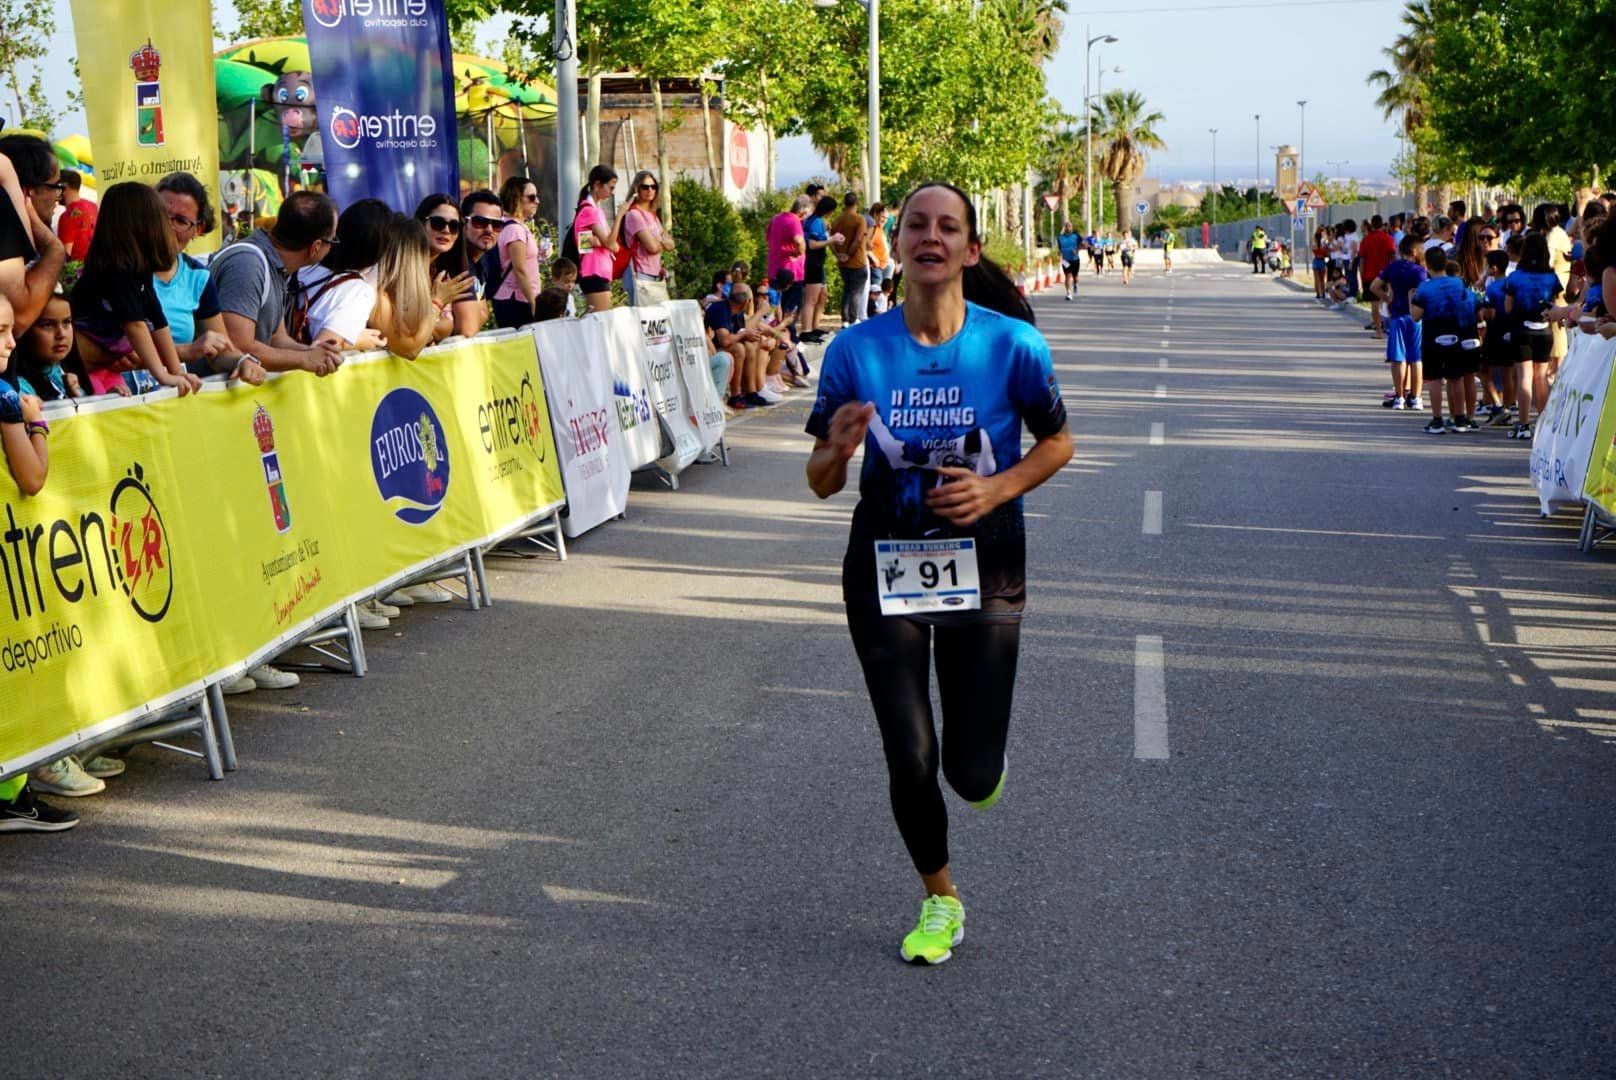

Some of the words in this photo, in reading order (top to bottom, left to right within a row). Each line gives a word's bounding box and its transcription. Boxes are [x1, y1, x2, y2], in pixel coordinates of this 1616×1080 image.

[909, 386, 960, 407] ROAD
[889, 406, 975, 428] RUNNING
[918, 559, 958, 589] 91
[1, 622, 83, 674] deportivo
